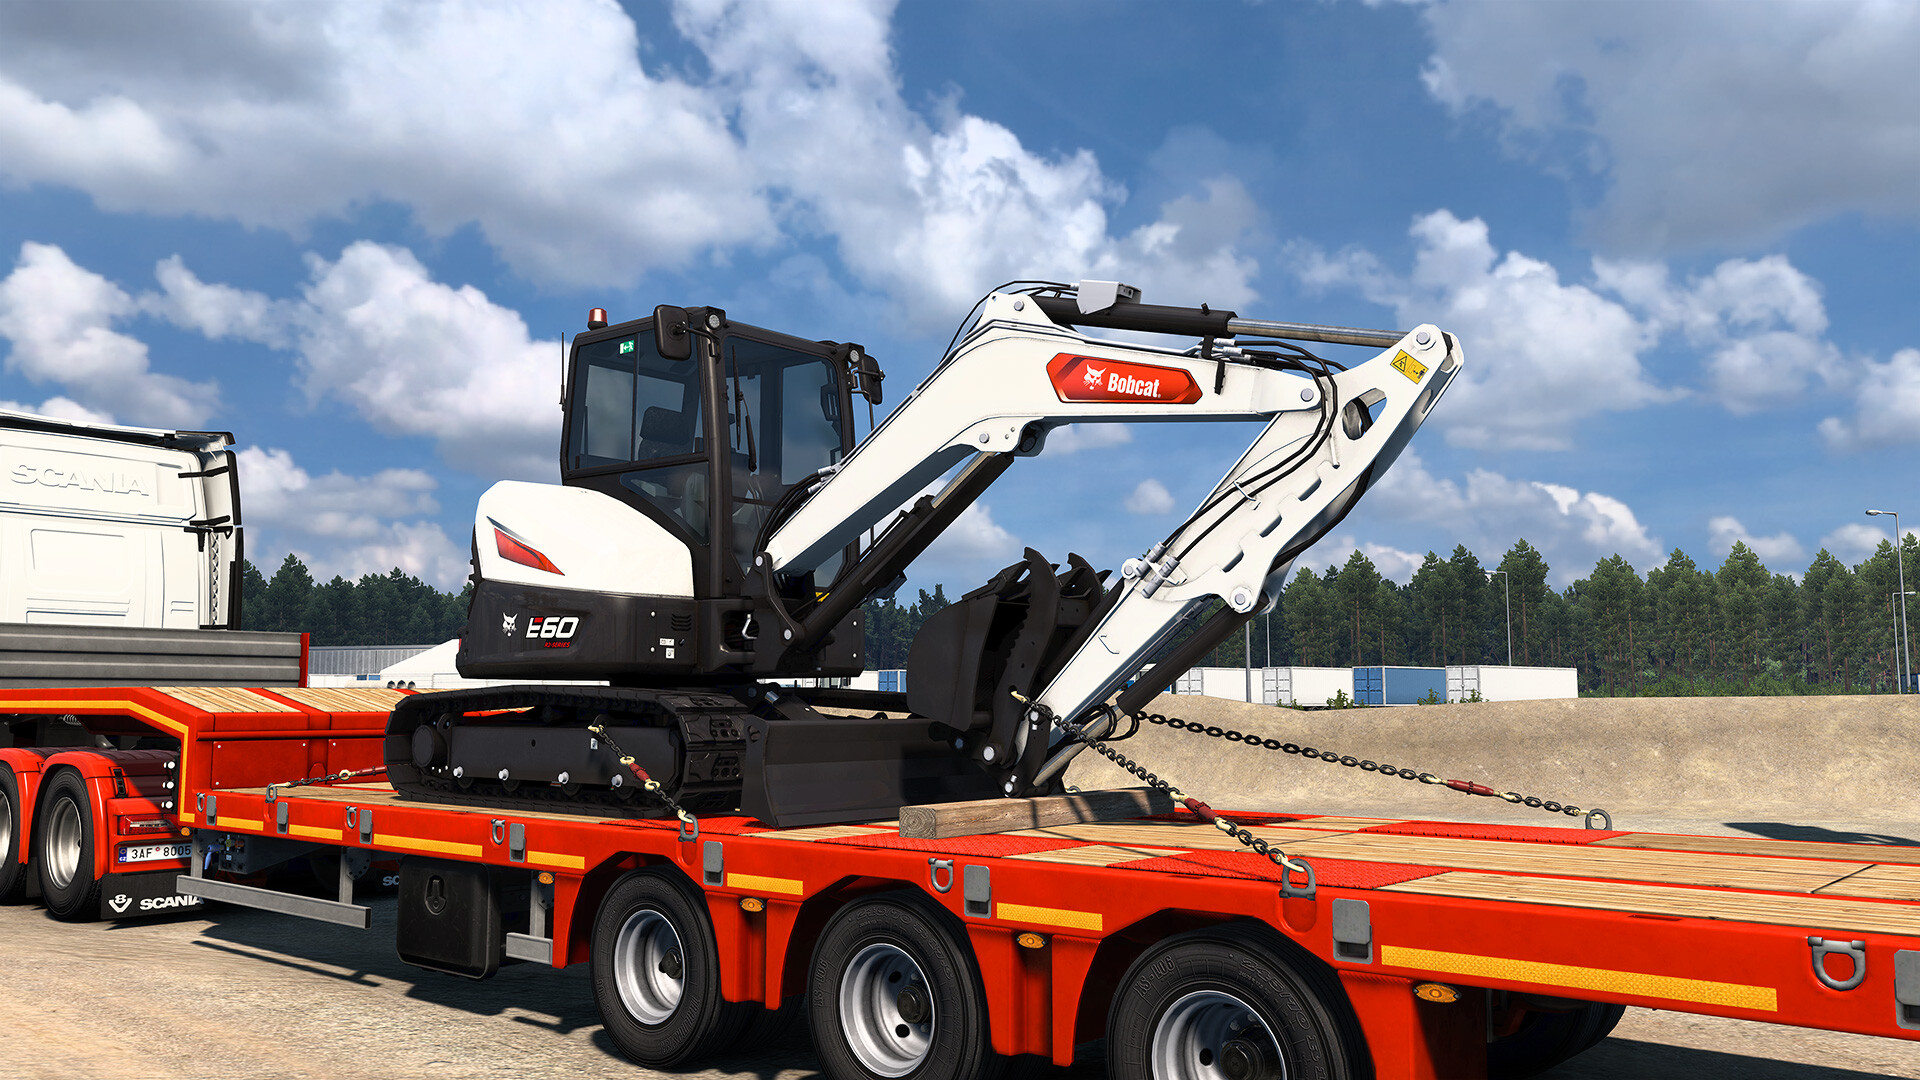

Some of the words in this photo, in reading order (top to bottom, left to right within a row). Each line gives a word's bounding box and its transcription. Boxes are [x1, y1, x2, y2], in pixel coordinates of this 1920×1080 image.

[1107, 372, 1160, 398] Bobcat
[10, 464, 149, 497] SCANIA
[525, 617, 580, 639] E60
[131, 848, 153, 860] 3AF
[163, 845, 192, 857] 8005
[140, 895, 205, 911] SCANIA
